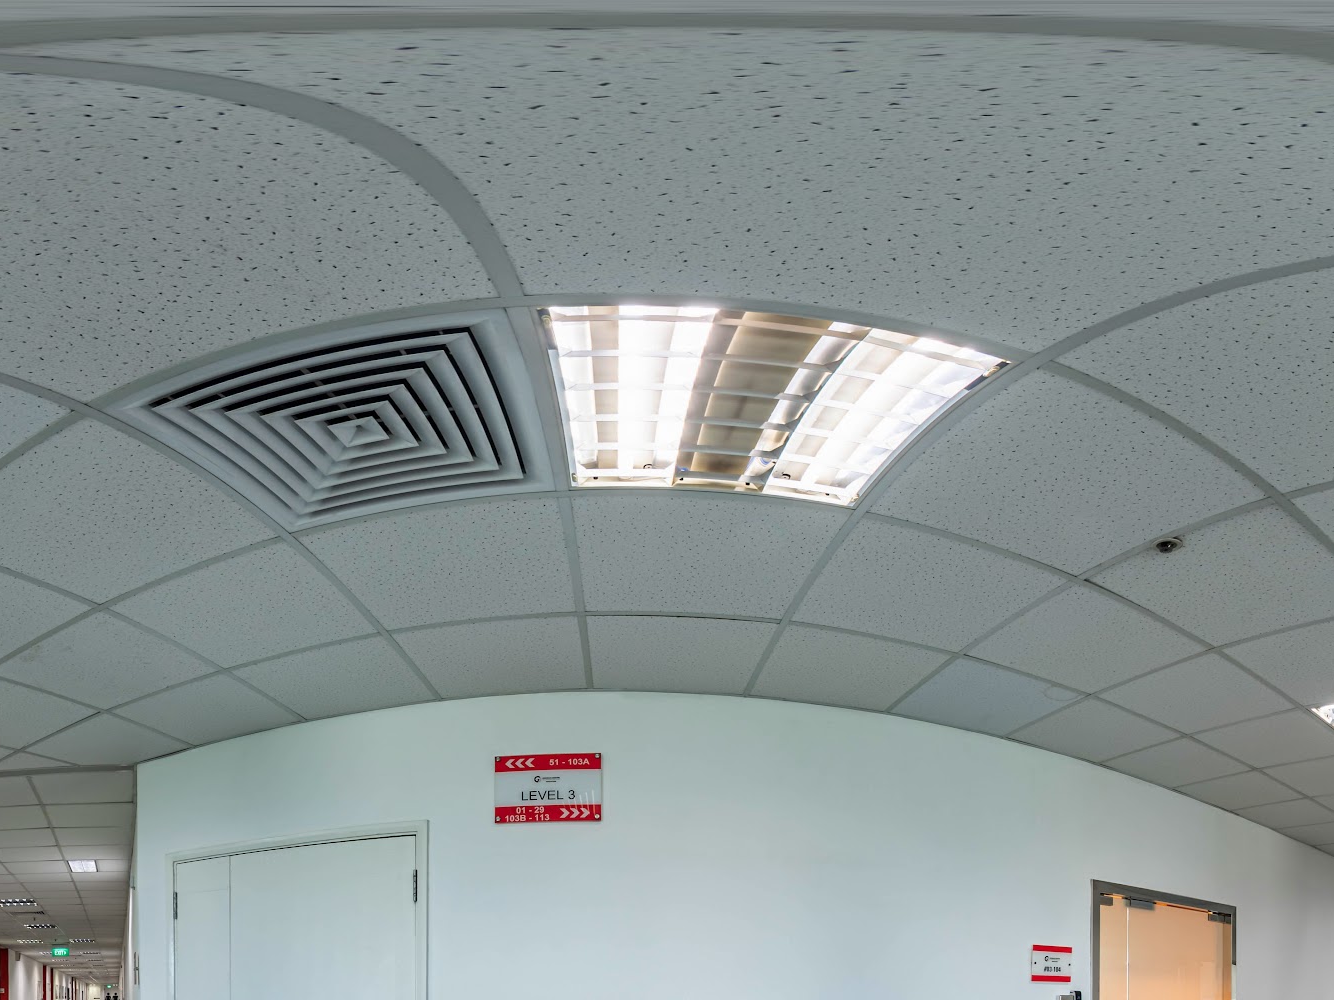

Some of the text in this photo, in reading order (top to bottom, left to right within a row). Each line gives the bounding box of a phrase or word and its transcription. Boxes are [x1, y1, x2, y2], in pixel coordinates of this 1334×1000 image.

[521, 790, 576, 801] LEVEL 3
[505, 814, 526, 822] 103B
